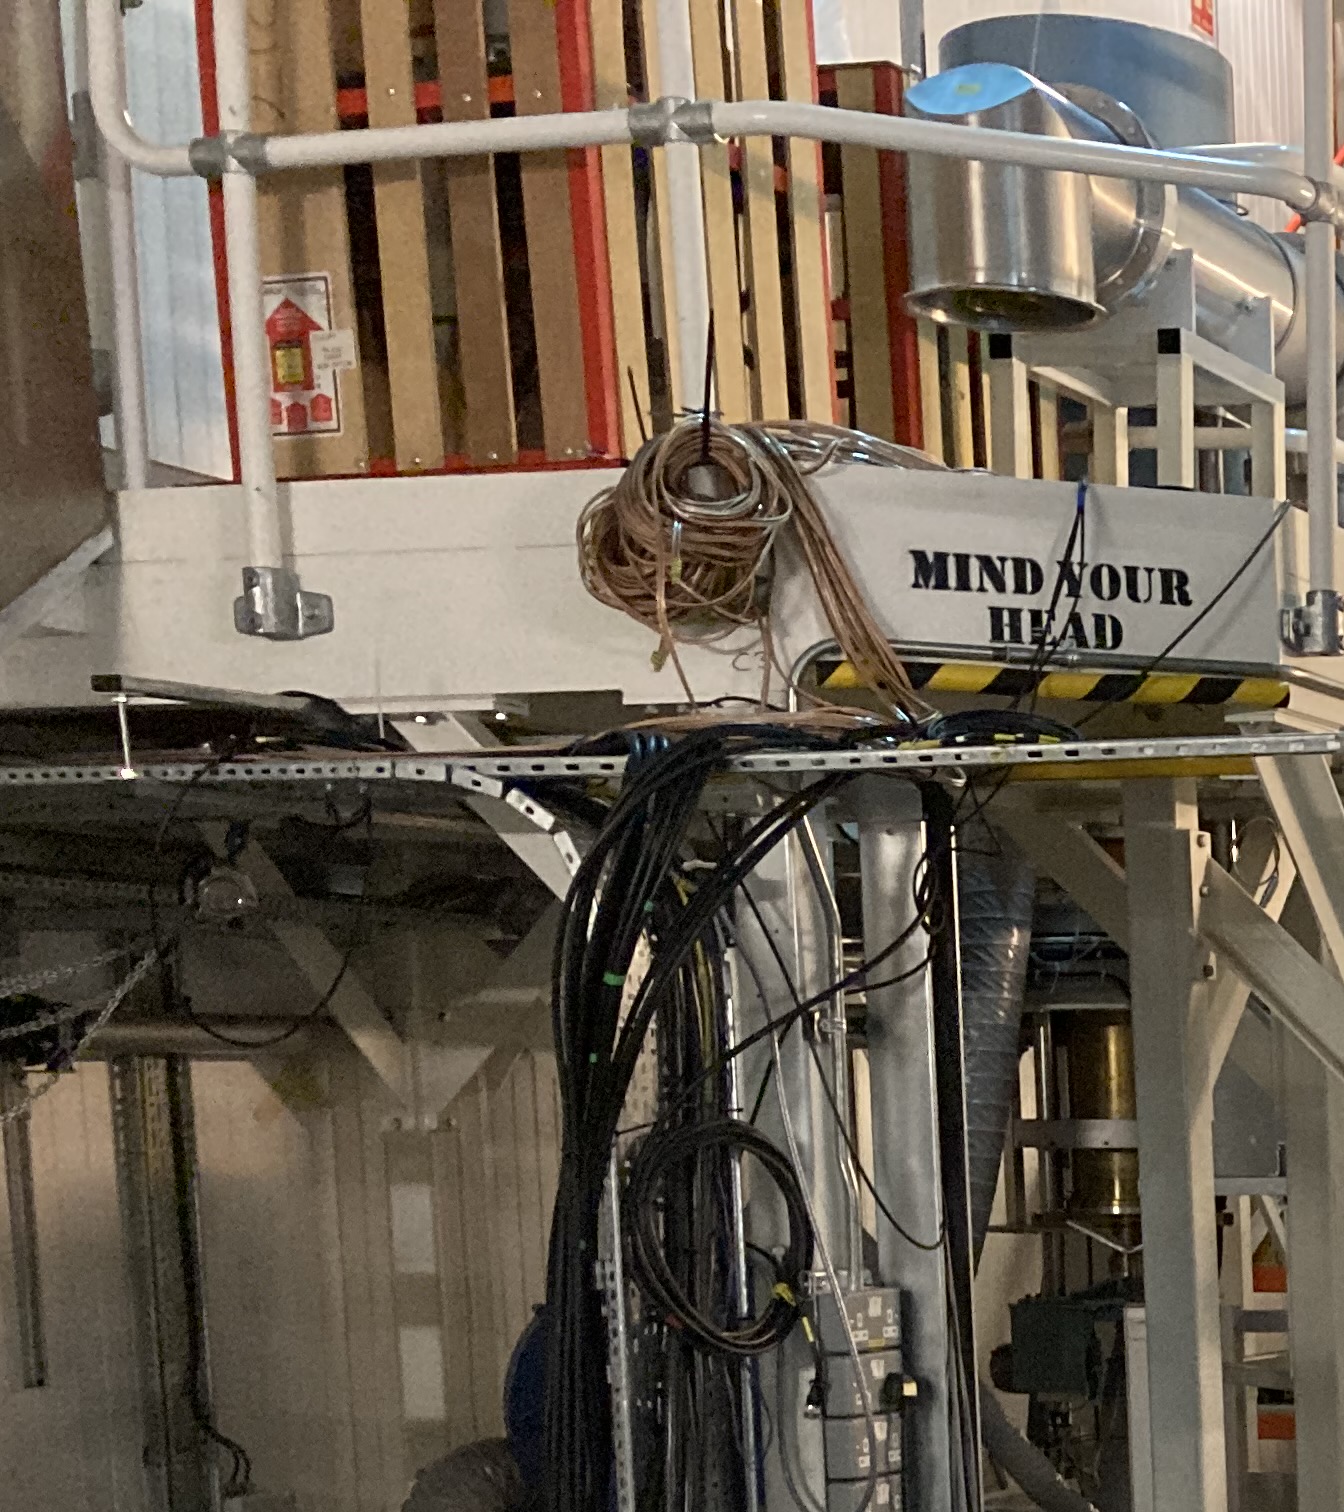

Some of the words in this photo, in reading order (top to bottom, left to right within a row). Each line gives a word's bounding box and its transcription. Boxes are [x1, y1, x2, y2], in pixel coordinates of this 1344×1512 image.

[908, 549, 1045, 595] MIND
[1056, 559, 1193, 607] YOUR
[987, 606, 1124, 650] HEAD
